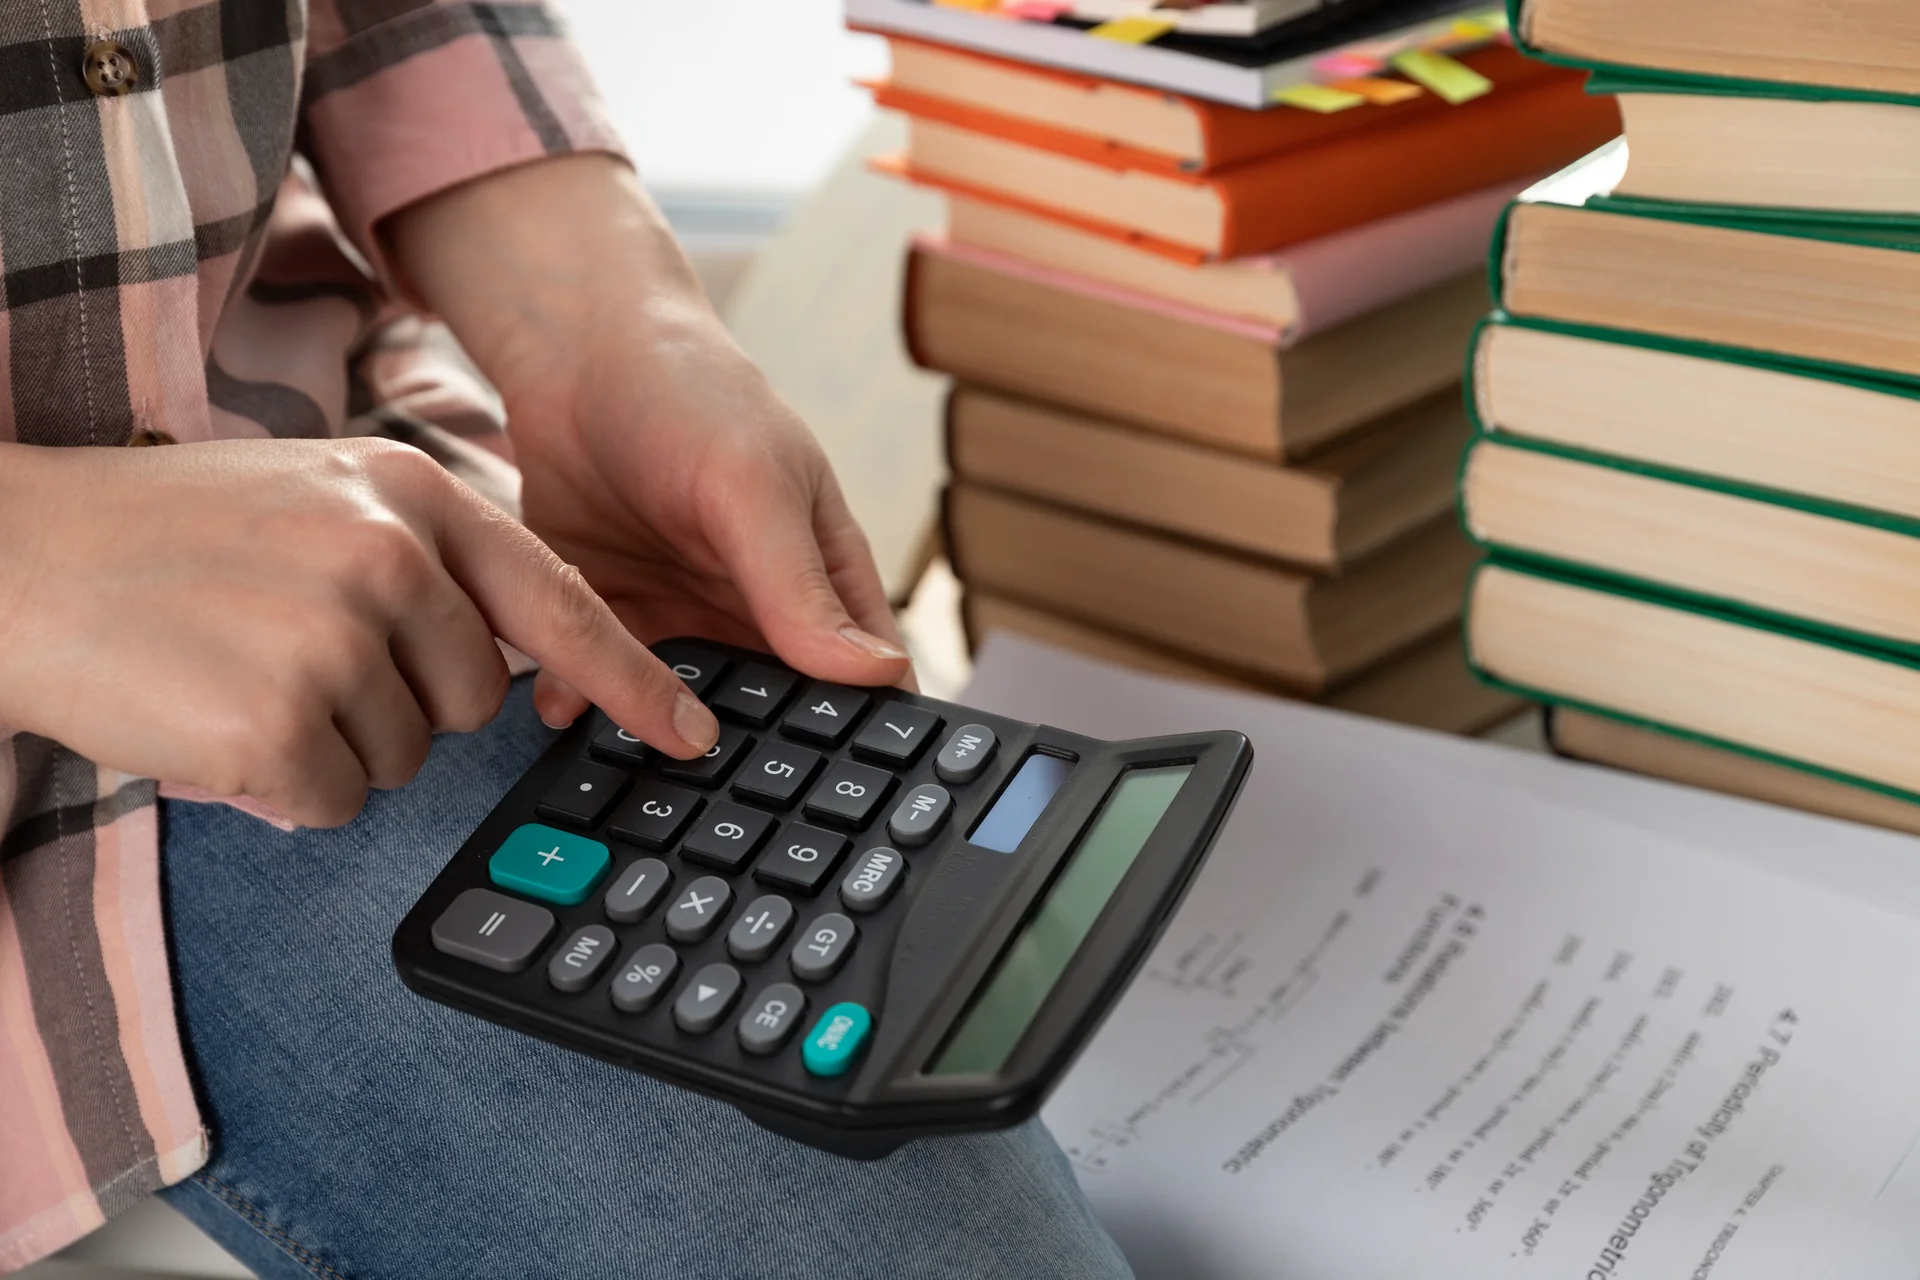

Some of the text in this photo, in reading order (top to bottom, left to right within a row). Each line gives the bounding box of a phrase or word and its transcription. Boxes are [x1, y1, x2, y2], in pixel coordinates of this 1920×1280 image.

[740, 686, 768, 697] 1
[810, 701, 838, 718] 4
[884, 721, 914, 739] 7
[954, 734, 982, 758] M+
[764, 760, 795, 778] 5
[835, 781, 866, 797] 8
[642, 800, 673, 817] 3
[714, 822, 745, 840] 6
[787, 845, 819, 862] 9
[853, 853, 893, 894] MRC
[564, 936, 600, 968] MU
[808, 929, 838, 957] GT
[755, 1000, 787, 1029] CE
[1695, 1044, 1782, 1142] Periodicity
[1586, 1158, 1699, 1280] Trigonometric
